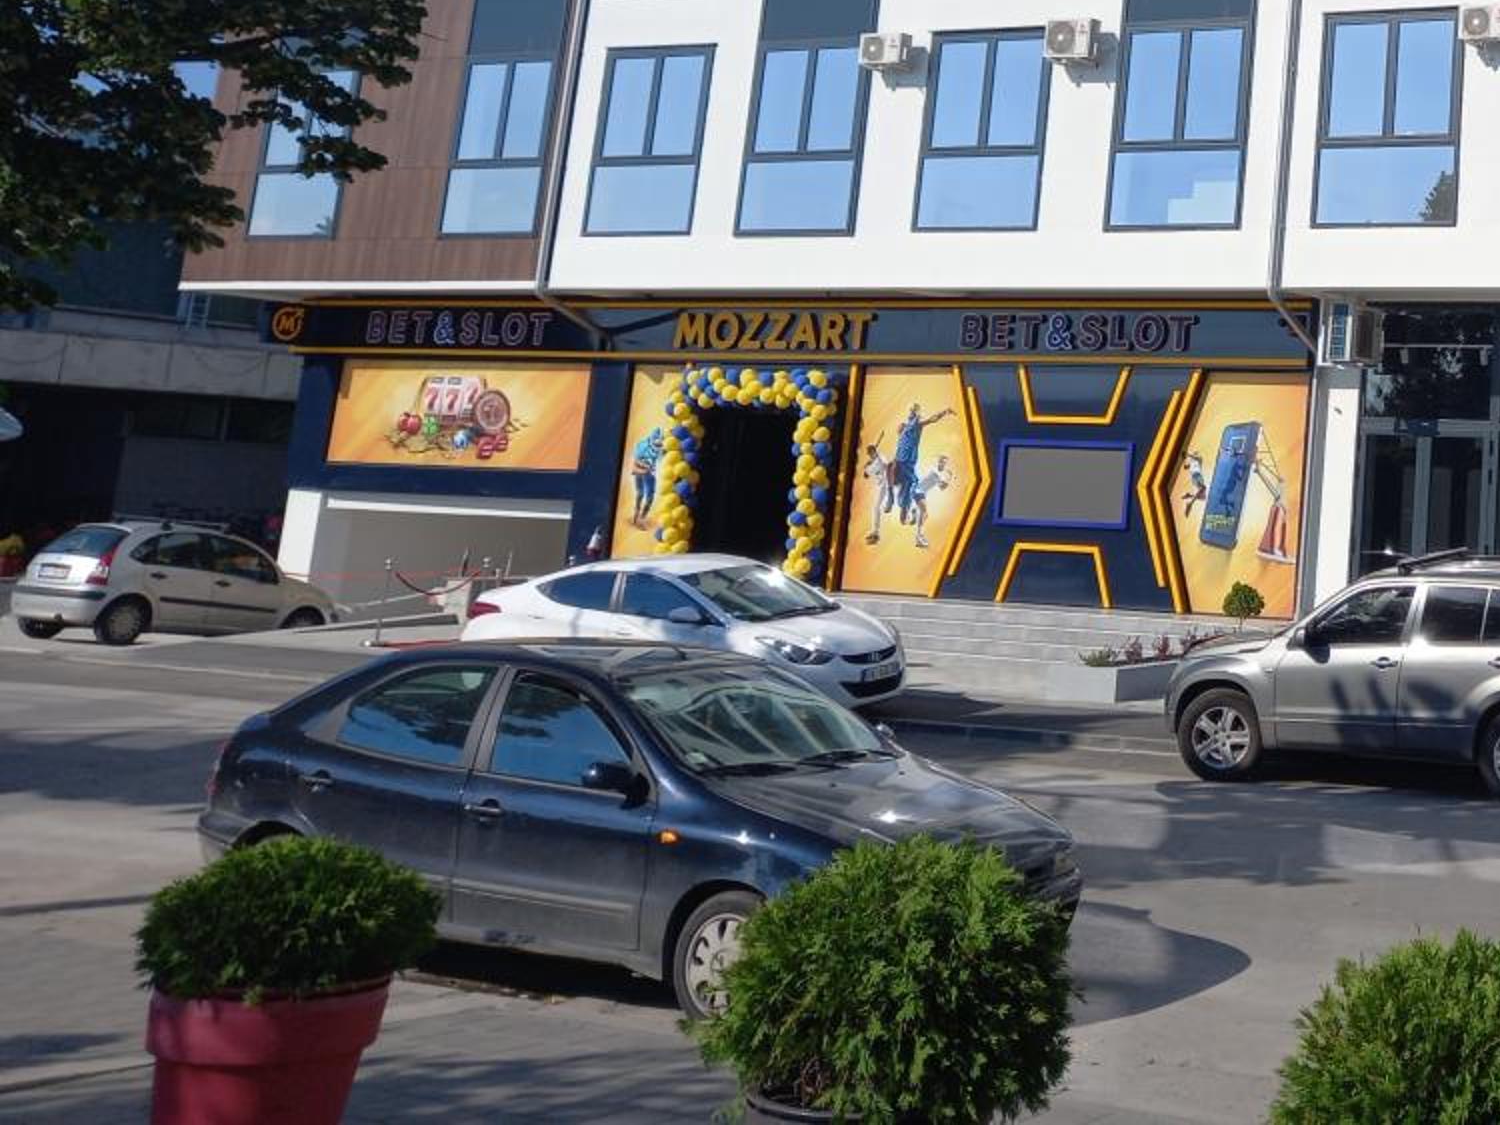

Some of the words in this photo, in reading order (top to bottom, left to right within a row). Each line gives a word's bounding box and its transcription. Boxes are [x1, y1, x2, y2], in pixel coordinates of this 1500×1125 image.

[365, 309, 552, 347] BET&SLOT
[673, 311, 874, 351] MOZZART
[959, 313, 1199, 352] BET&SLOT
